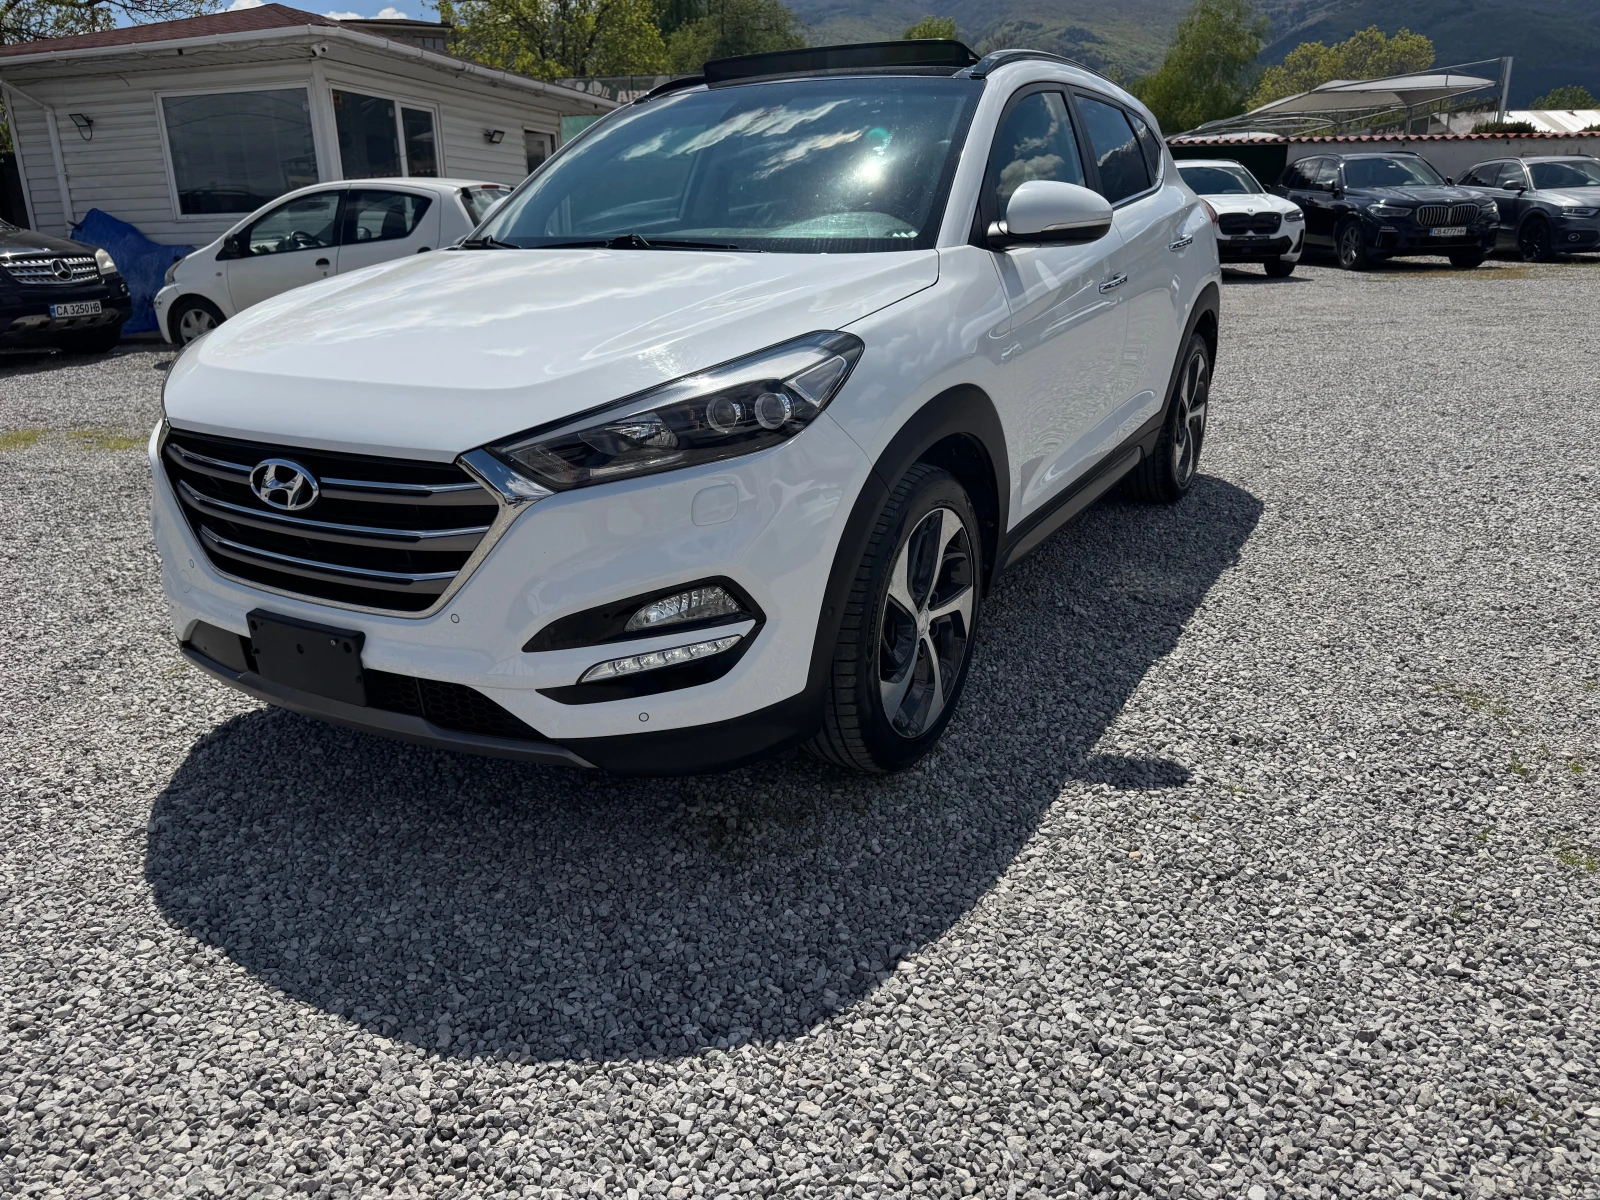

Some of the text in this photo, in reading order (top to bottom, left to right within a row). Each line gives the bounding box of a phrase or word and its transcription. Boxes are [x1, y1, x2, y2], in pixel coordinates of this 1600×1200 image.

[56, 302, 100, 315] CA 3250 HB
